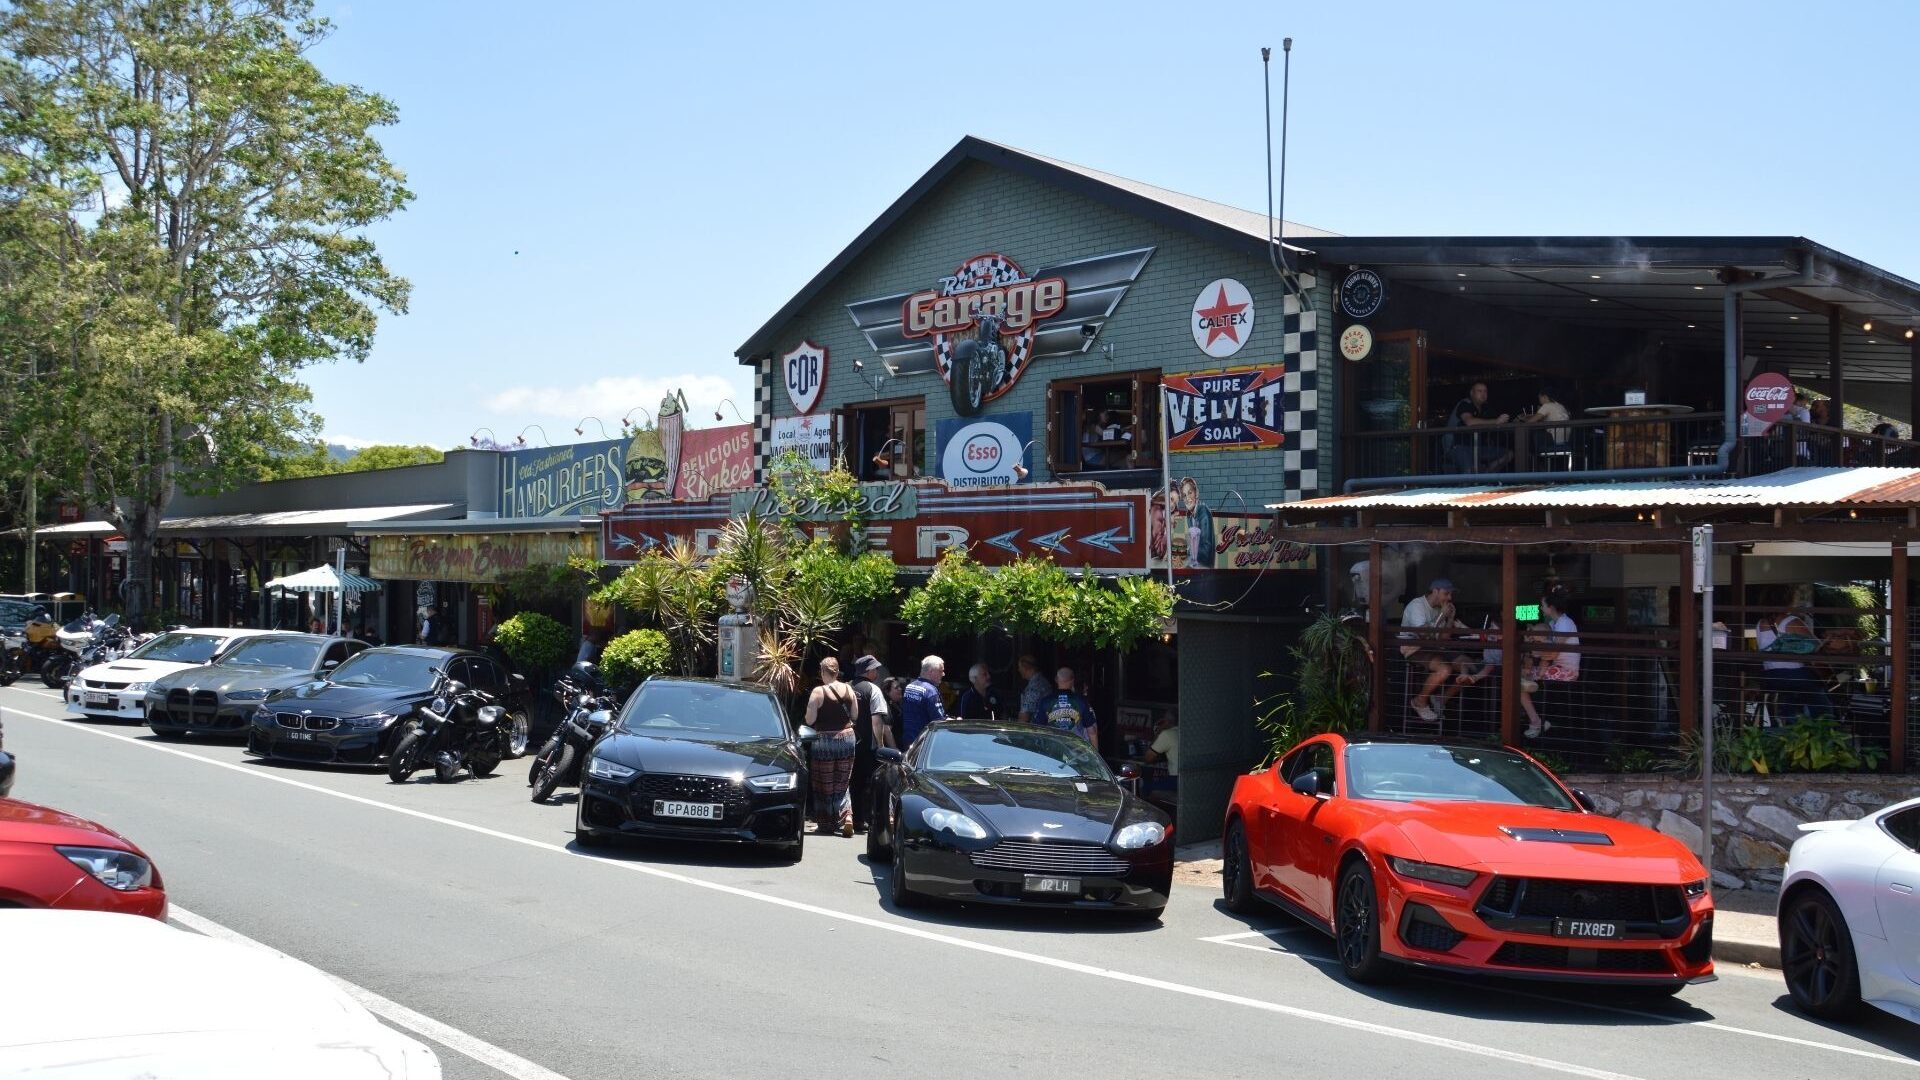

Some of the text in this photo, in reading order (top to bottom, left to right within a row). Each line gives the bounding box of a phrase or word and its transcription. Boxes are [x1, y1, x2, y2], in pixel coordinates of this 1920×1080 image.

[1345, 273, 1361, 289] YOUNG
[909, 280, 1063, 332] Garage
[1198, 311, 1248, 331] CALTEX
[788, 354, 818, 396] COR
[1202, 378, 1241, 394] PURE
[1167, 381, 1280, 435] VELVET
[778, 429, 796, 440] Local
[813, 427, 832, 439] Agen
[1203, 426, 1242, 442] SOAP
[682, 431, 750, 480] DELICIOUS
[967, 443, 998, 461] Esso
[502, 446, 624, 518] HAMBURGERS
[681, 457, 754, 499] Shakes
[953, 475, 1010, 488] DISTRIBUTOR
[667, 803, 710, 817] GPA888
[1570, 921, 1616, 937] FIX8ED
